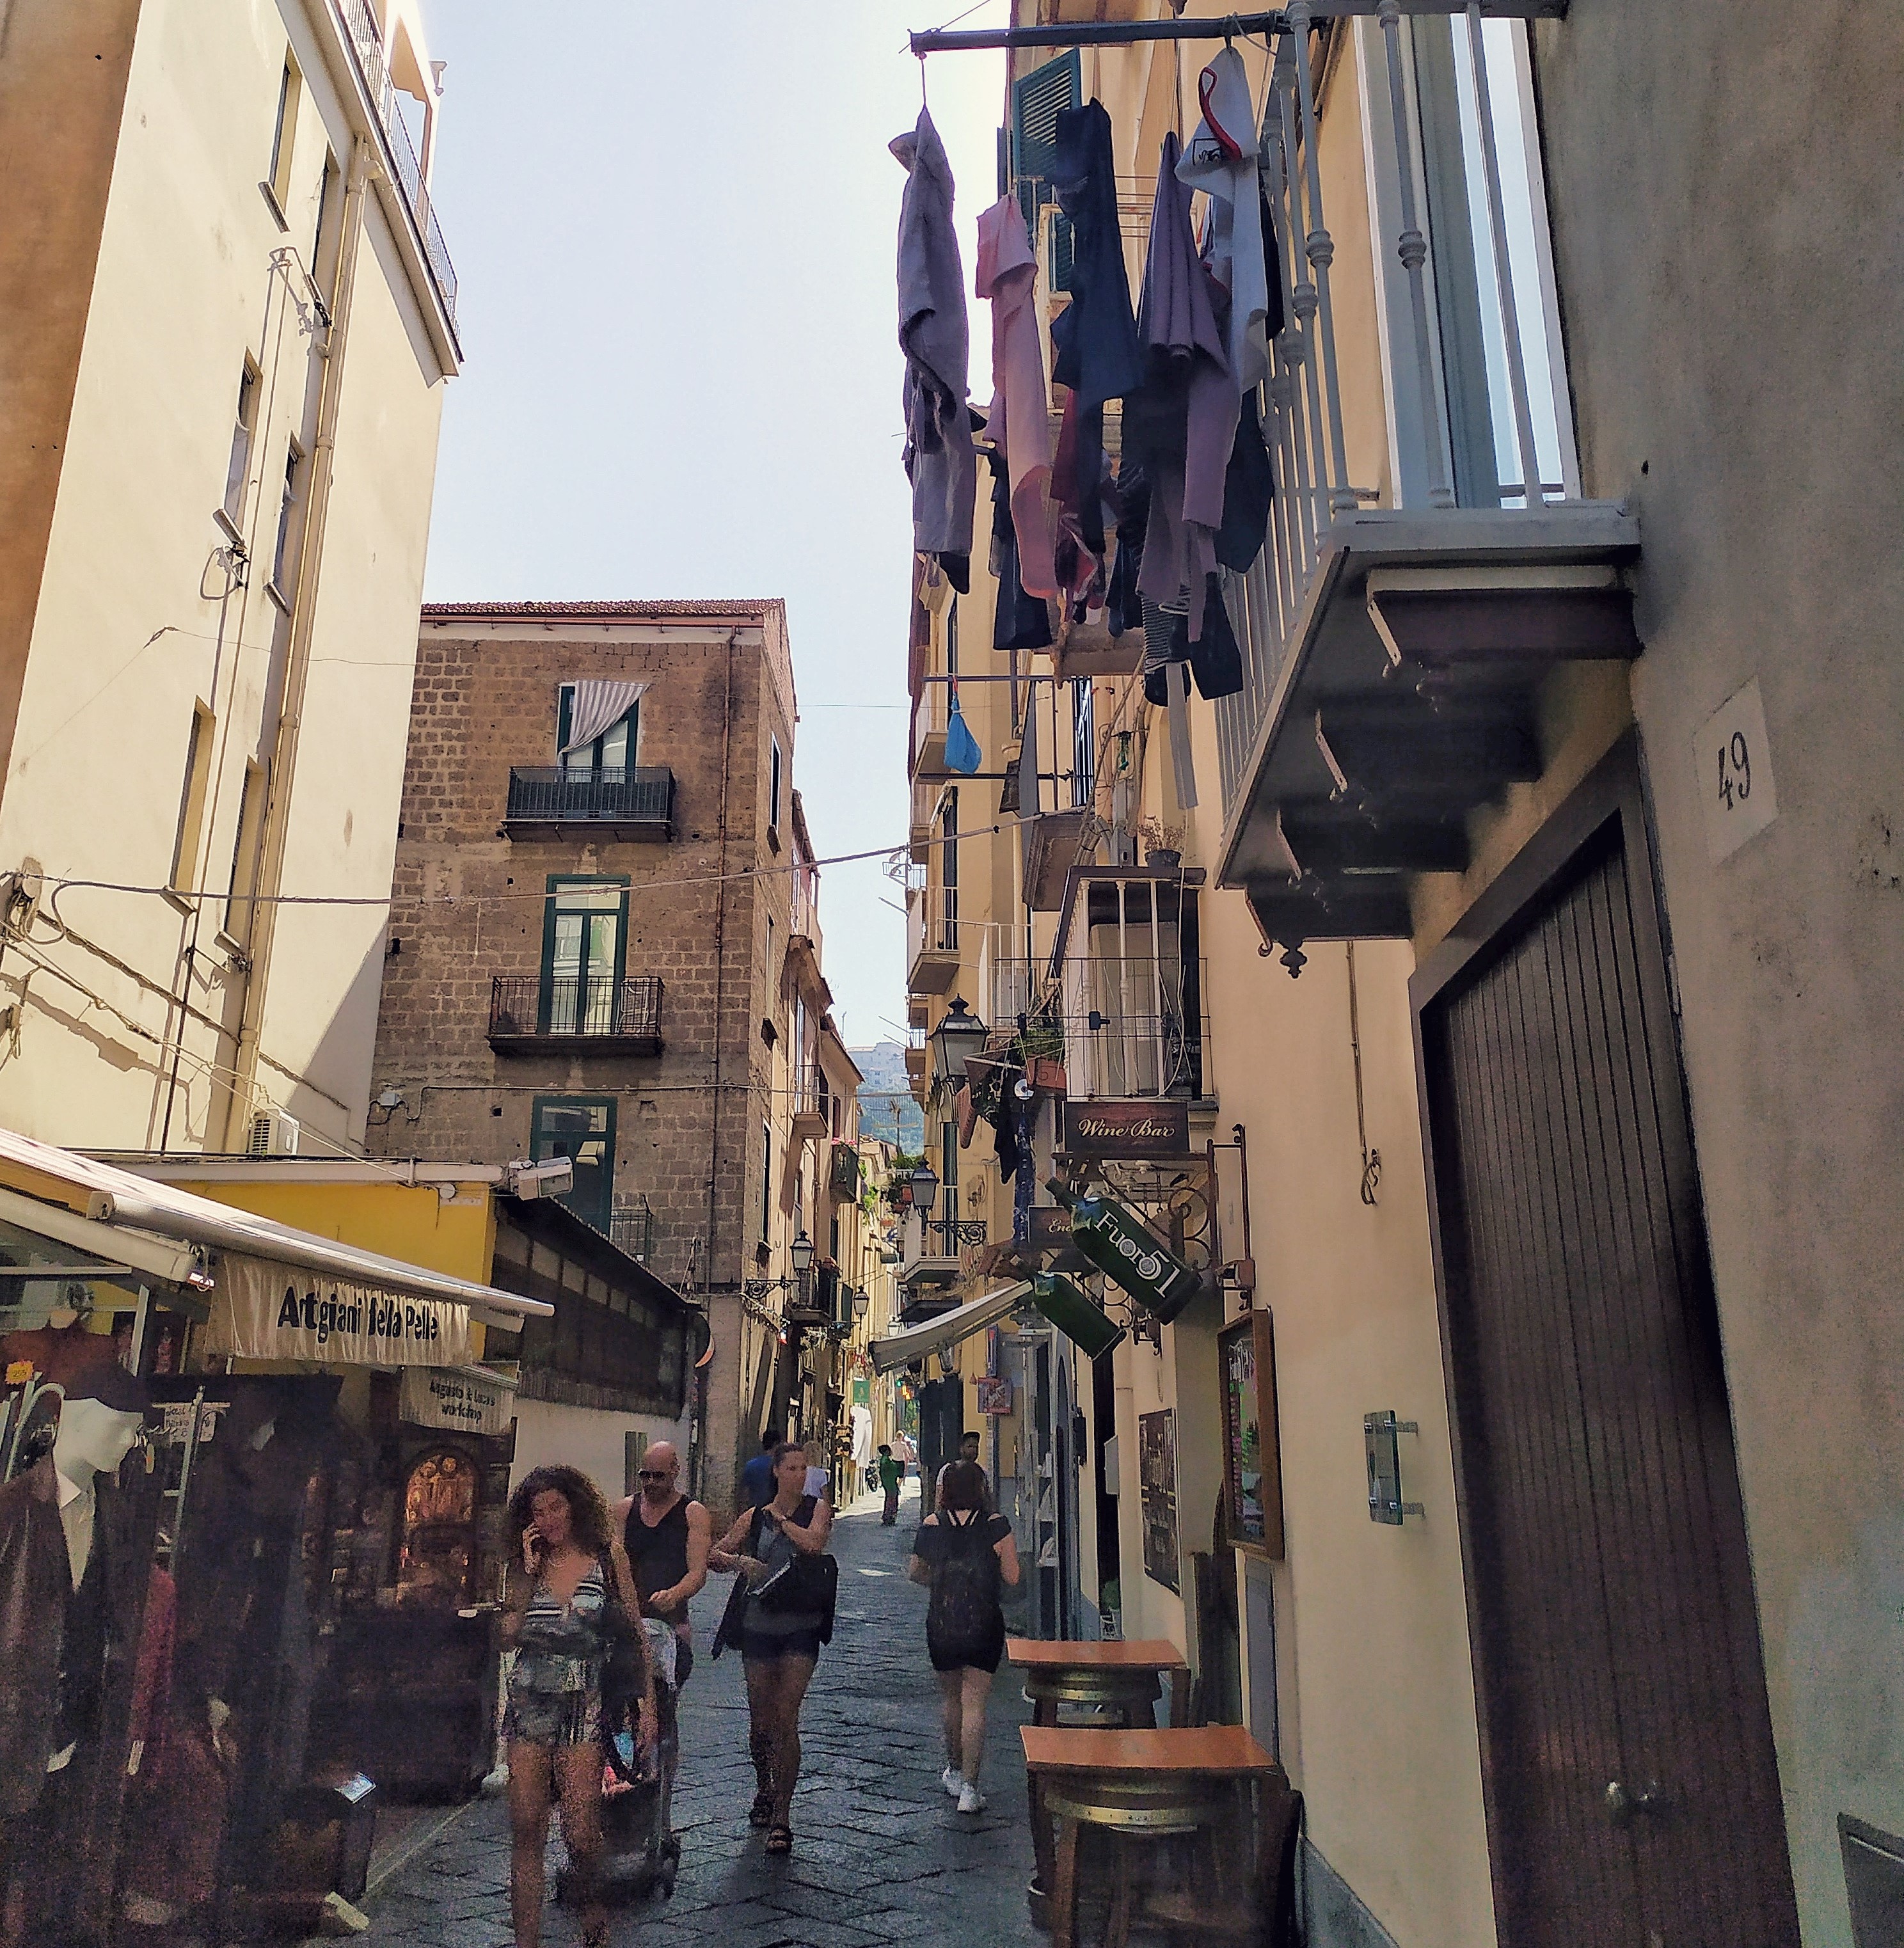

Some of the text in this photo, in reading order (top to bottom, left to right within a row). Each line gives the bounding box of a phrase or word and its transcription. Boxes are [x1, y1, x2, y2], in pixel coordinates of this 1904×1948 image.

[1718, 731, 1750, 811] 49
[1078, 1117, 1175, 1137] Wine Bar
[405, 1304, 438, 1341] Pelle
